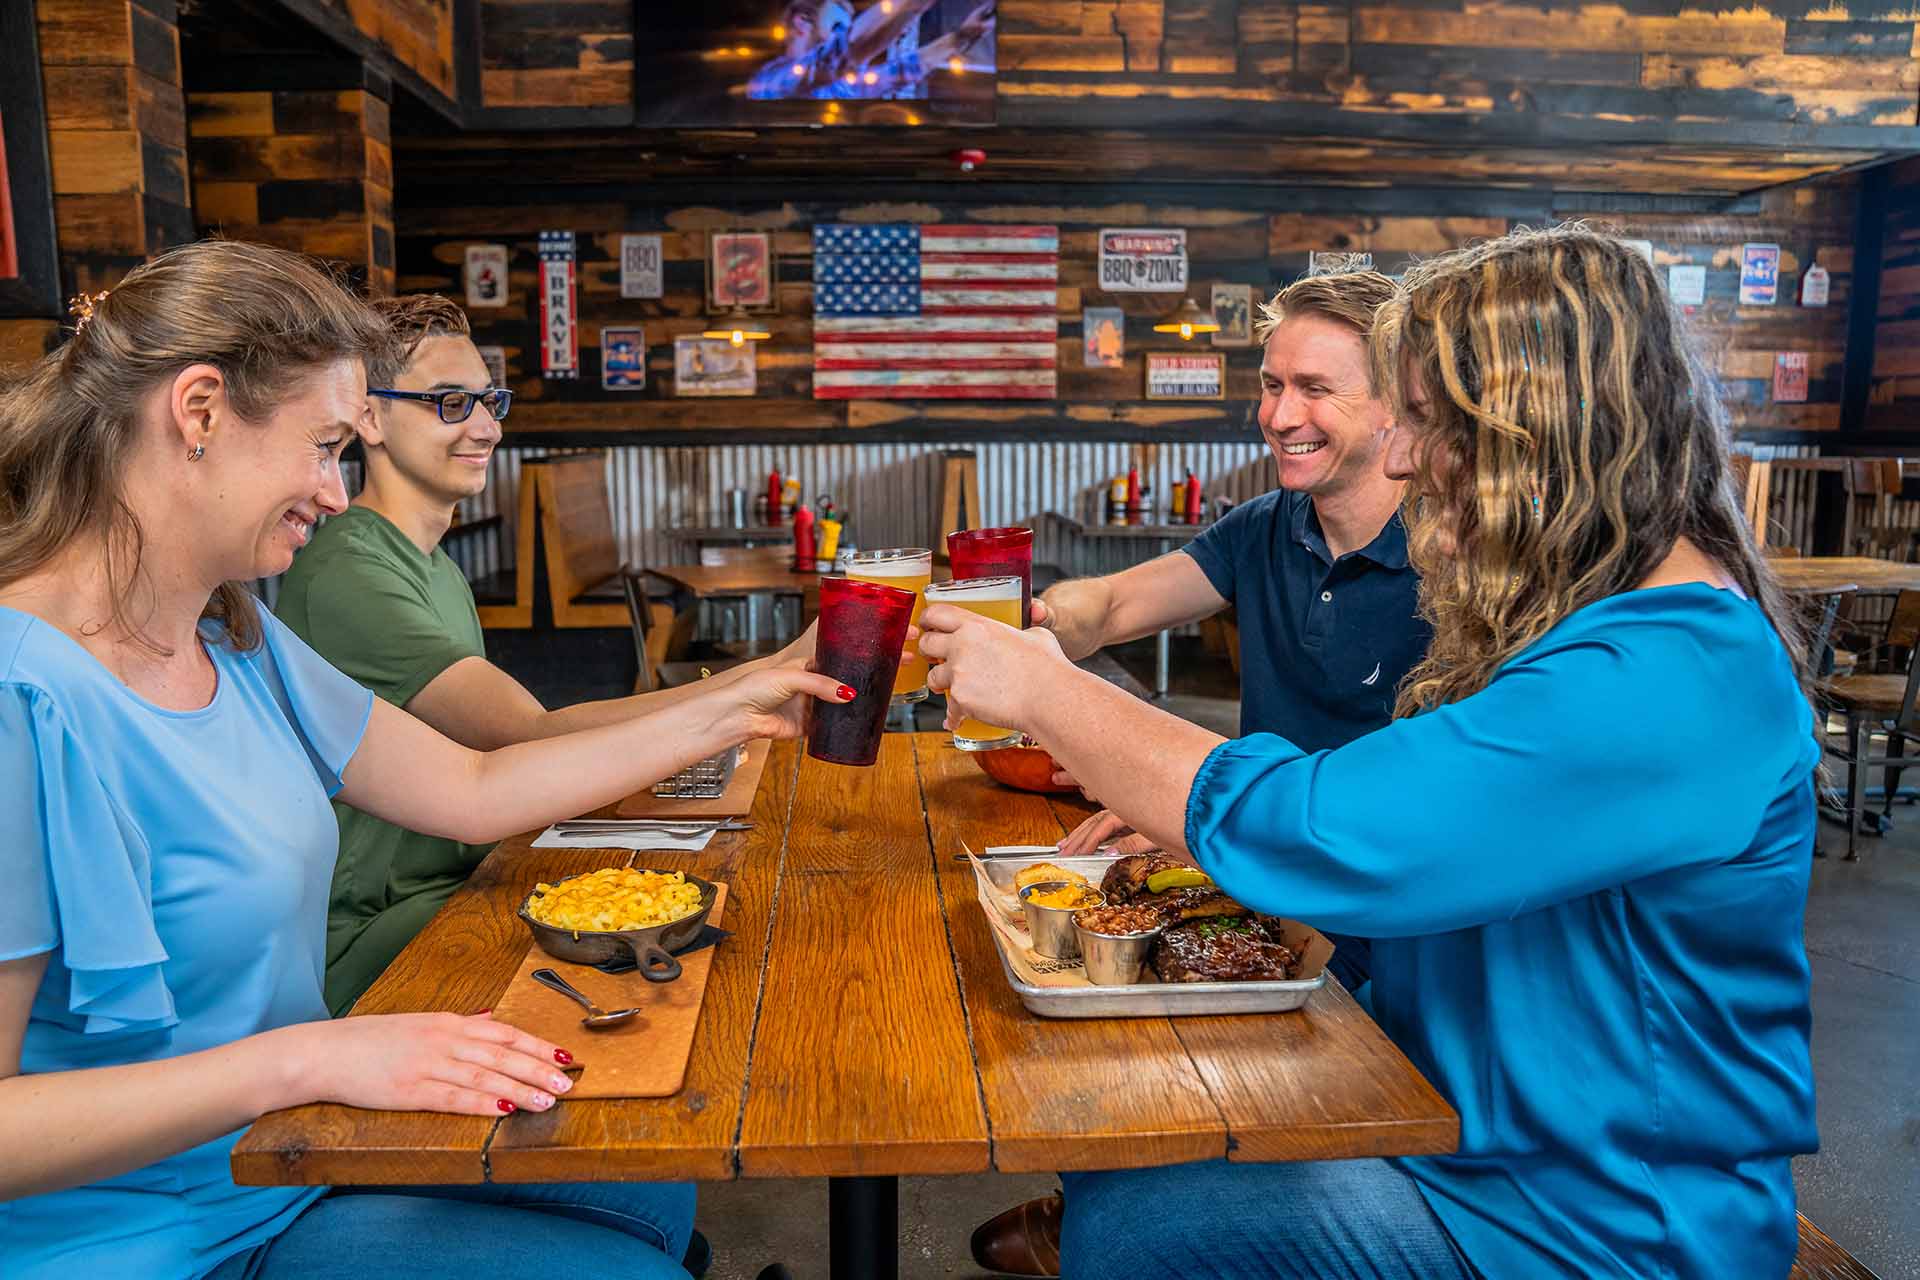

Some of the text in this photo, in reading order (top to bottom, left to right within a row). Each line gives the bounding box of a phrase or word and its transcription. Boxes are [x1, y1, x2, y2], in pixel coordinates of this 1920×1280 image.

[625, 246, 657, 273] BBQ
[1104, 258, 1183, 286] BBQ ZONE
[551, 276, 568, 364] BRAVE
